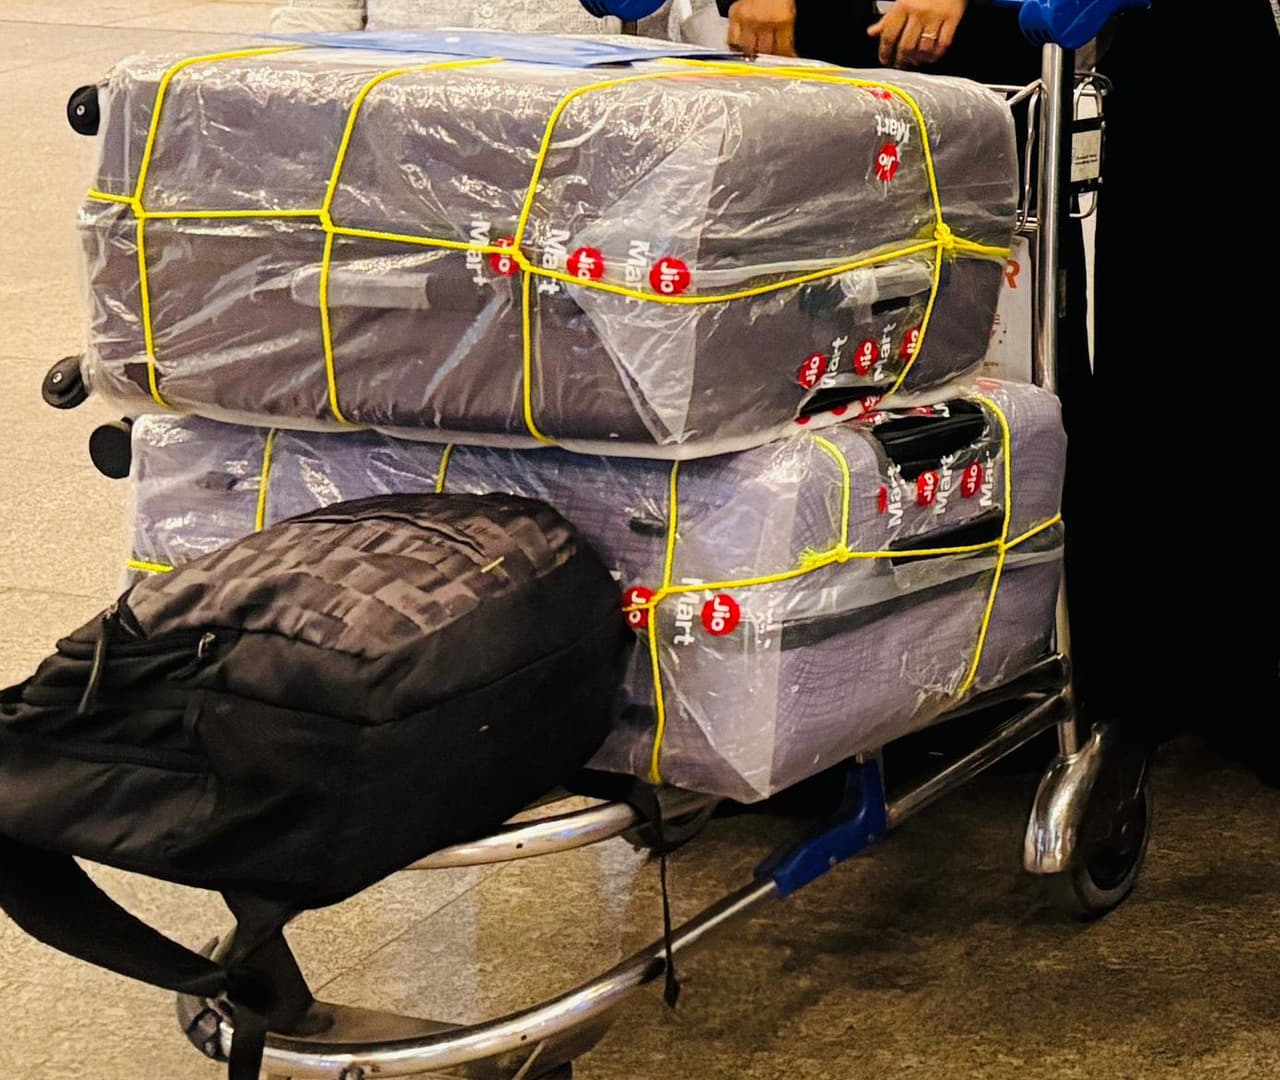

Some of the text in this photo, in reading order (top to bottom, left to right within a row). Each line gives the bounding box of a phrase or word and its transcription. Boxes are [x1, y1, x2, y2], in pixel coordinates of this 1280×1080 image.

[538, 228, 570, 295] Mat
[577, 251, 595, 281] Jio
[660, 261, 680, 293] Jio
[805, 356, 820, 385] Jio
[628, 590, 647, 624] Jo
[710, 596, 731, 632] Jio
